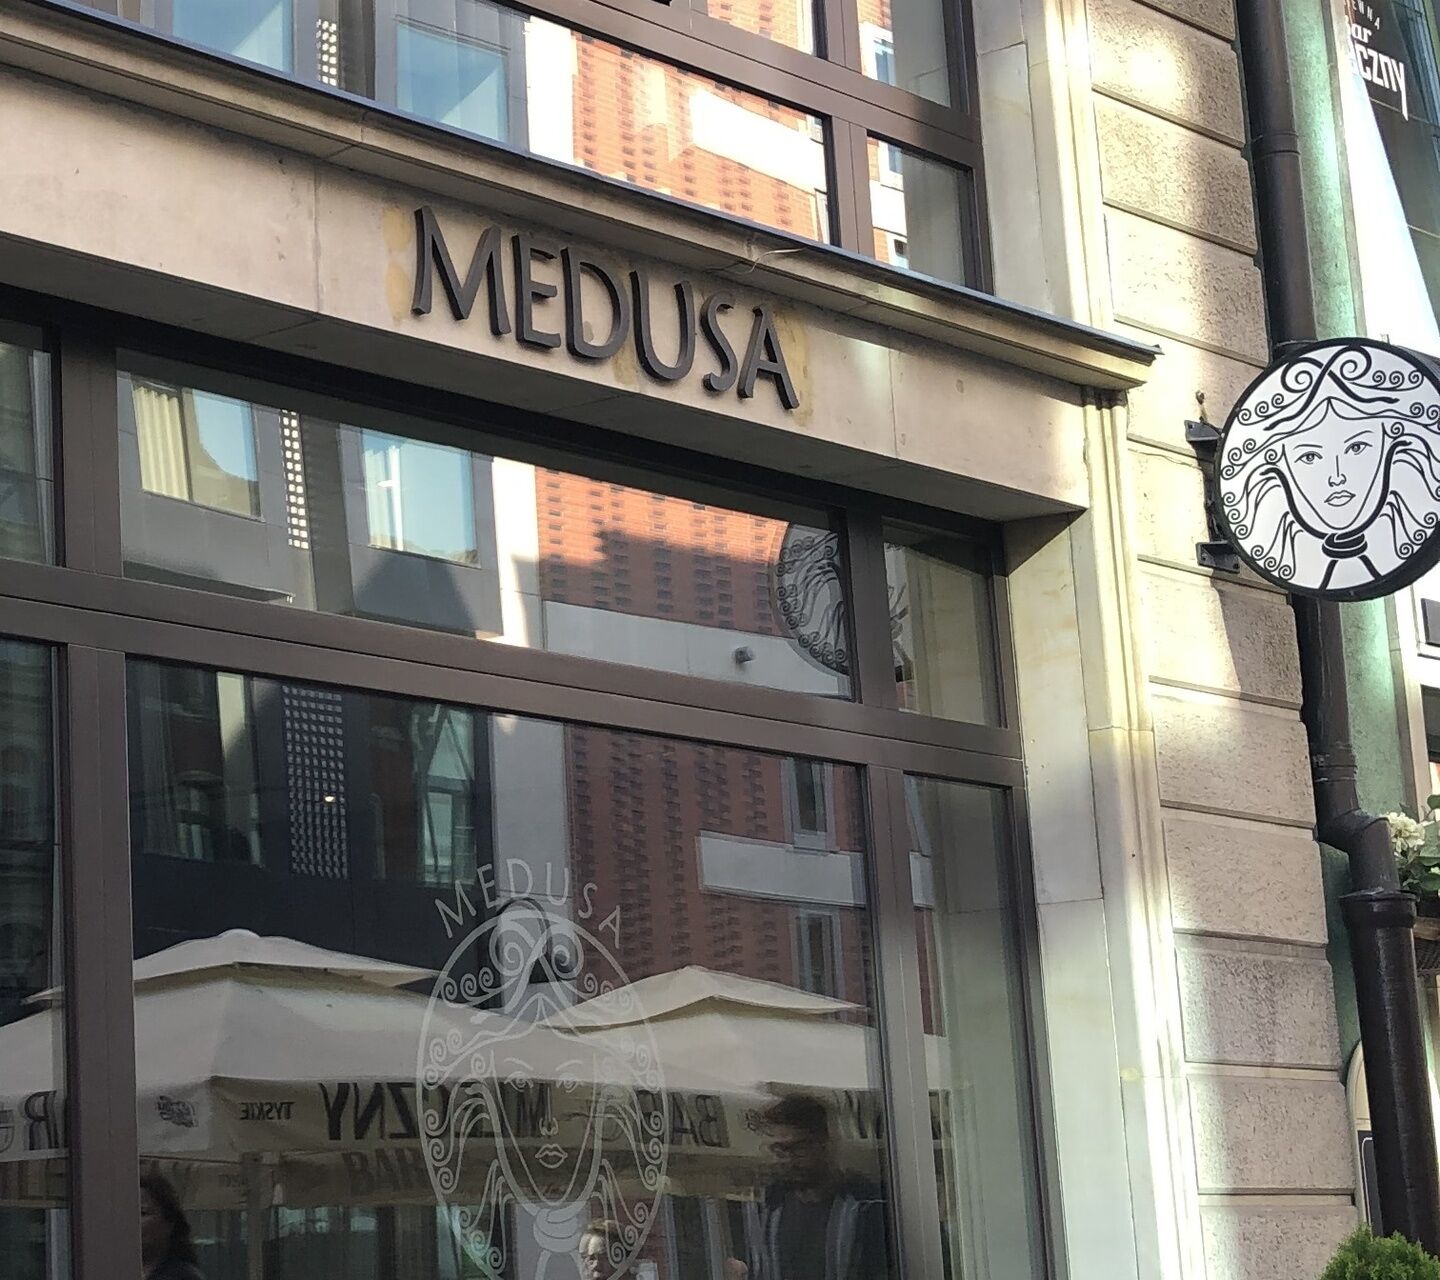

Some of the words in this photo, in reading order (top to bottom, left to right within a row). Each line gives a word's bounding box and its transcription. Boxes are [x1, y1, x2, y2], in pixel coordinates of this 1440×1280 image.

[1351, 22, 1373, 44] ar
[411, 205, 800, 410] MEDUSA
[434, 857, 621, 950] MEDUSA
